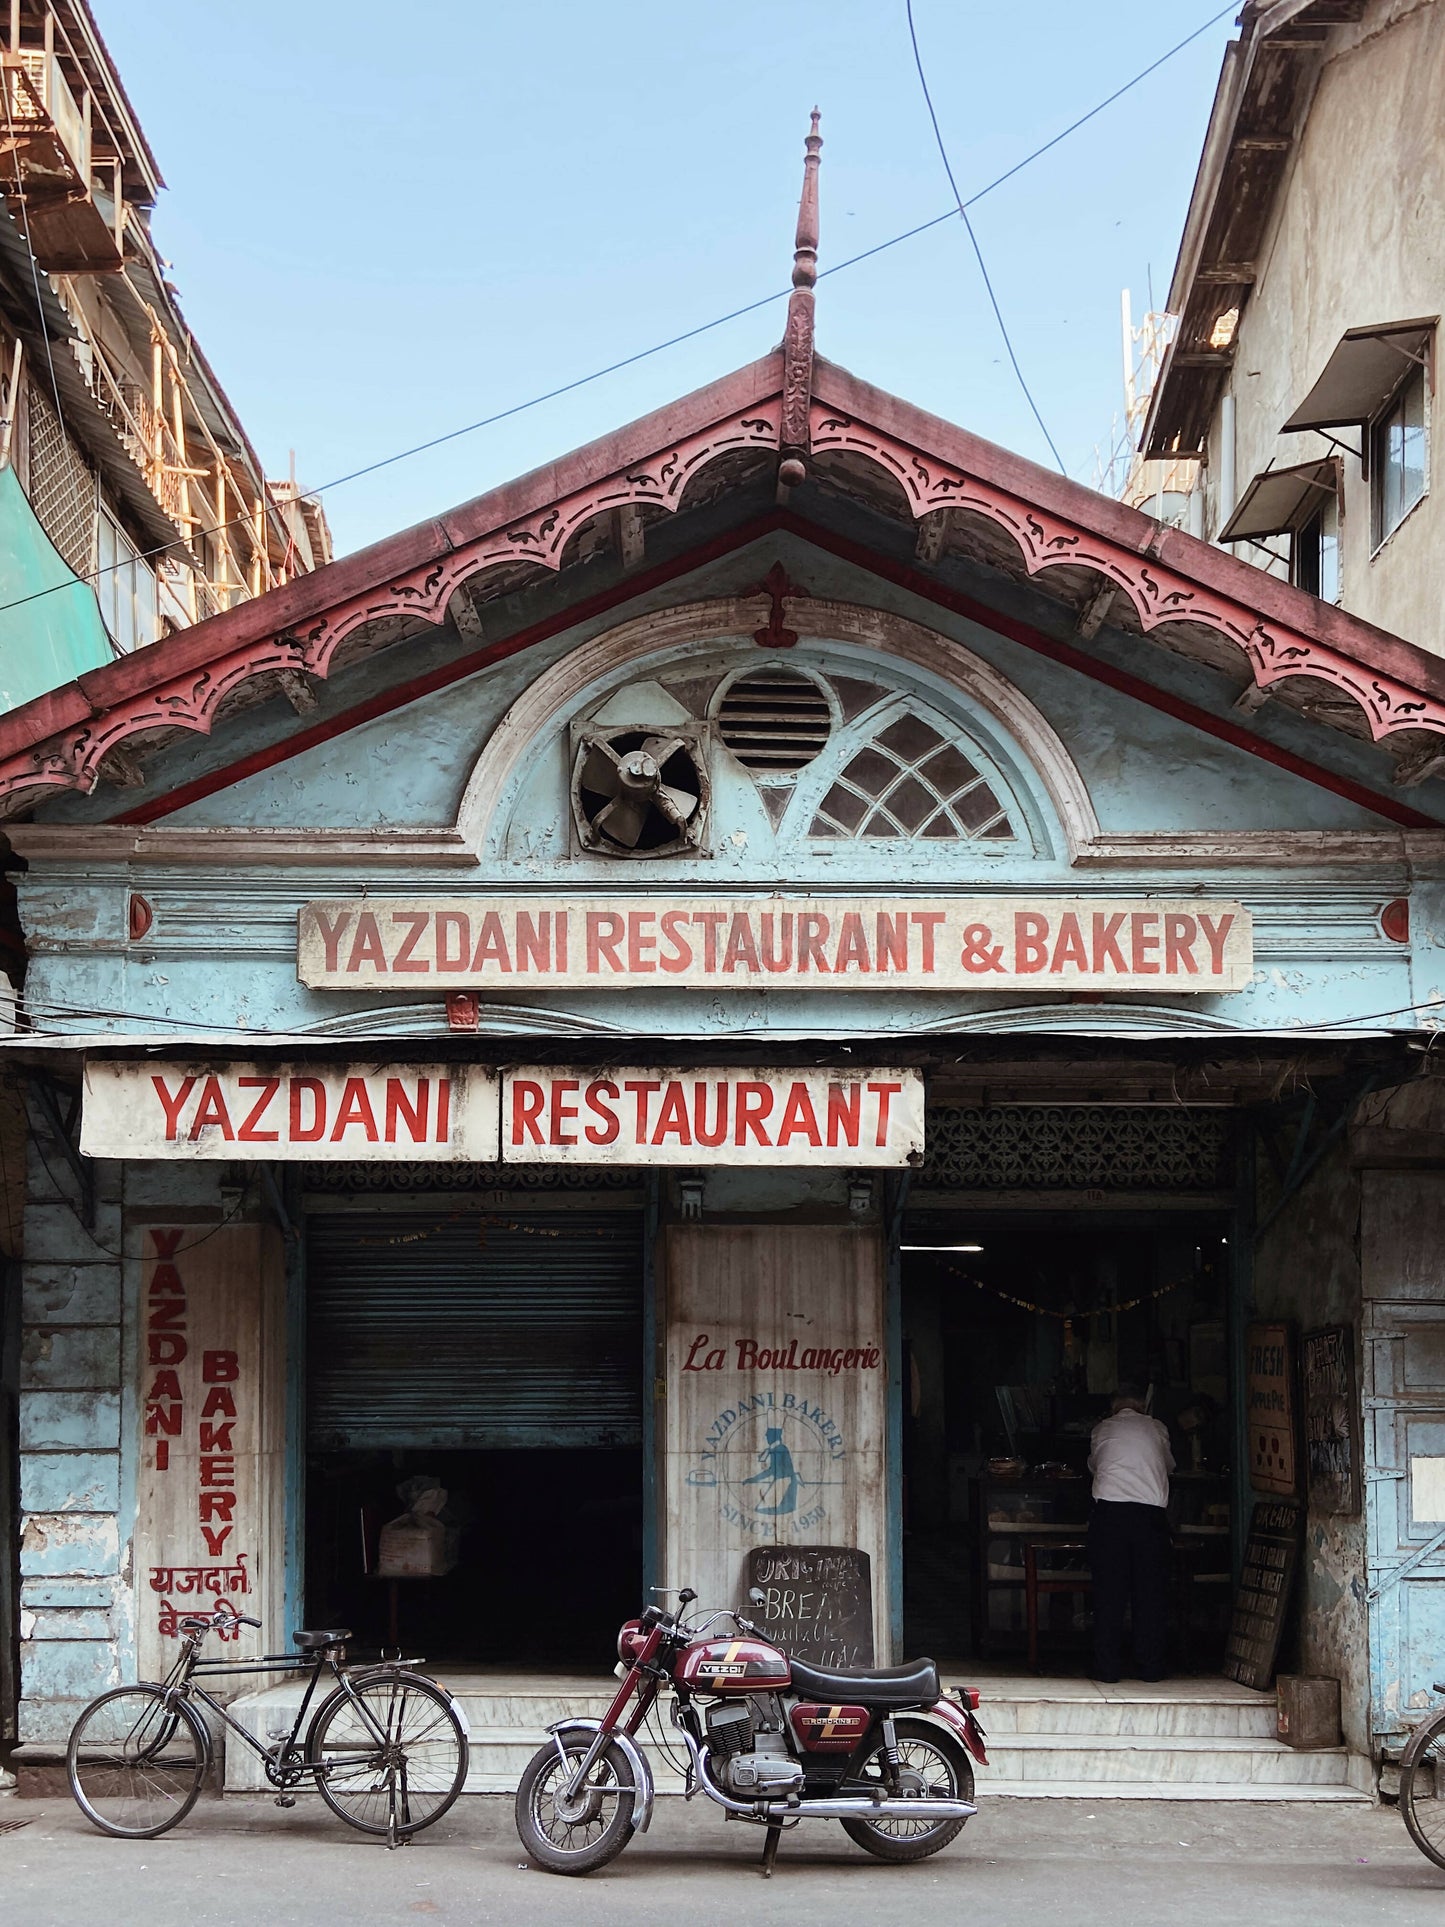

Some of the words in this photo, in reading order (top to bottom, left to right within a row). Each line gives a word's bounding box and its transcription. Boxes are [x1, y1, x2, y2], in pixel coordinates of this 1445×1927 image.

[316, 911, 568, 974] YAZDANI
[587, 911, 946, 975] RESTAURANT
[962, 923, 1005, 974] &
[1014, 912, 1236, 976] BAKERY
[151, 1075, 450, 1143] YAZDANI
[512, 1079, 903, 1149] RESTAURANT
[145, 1228, 188, 1471] YAZDANI
[682, 1334, 727, 1371] La
[1250, 1344, 1285, 1377] FRESH
[199, 1350, 240, 1557] BAKERY
[702, 1392, 775, 1461] YAZDANI
[781, 1392, 848, 1461] BAKERY
[719, 1502, 776, 1538] SINCE
